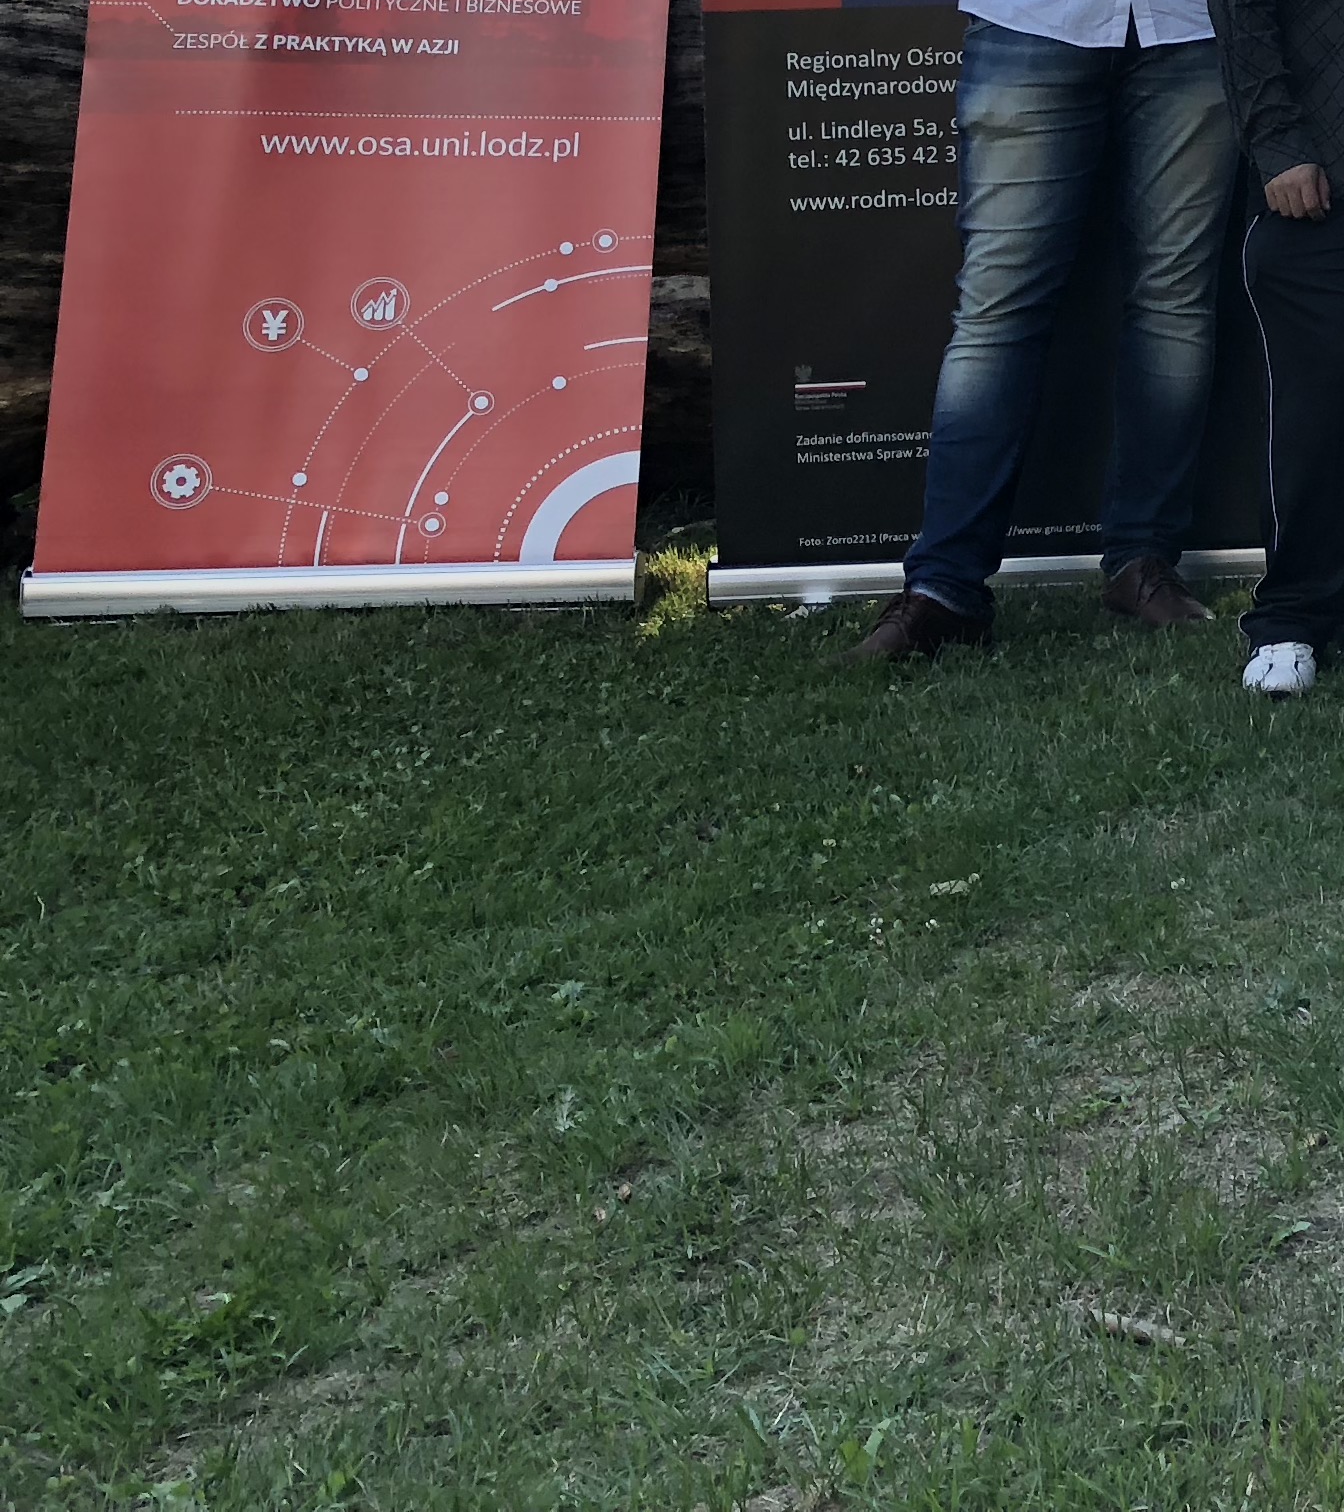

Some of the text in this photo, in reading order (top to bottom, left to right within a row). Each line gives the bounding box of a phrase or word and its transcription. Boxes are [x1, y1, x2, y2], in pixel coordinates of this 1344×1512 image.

[173, 30, 460, 56] ZESPÓŁ Z PRAKTYKĄ W AZJI
[786, 48, 901, 73] Regionalny
[786, 75, 958, 101] Międzynarodow
[788, 121, 813, 142] ul.
[821, 119, 906, 142] Lindleya
[913, 118, 945, 139] 5a,
[260, 130, 581, 163] www.osa.uni.lodz.pl
[787, 145, 957, 170] tel.: 42 635 42 3
[789, 187, 959, 212] www.rodm-lodz
[796, 433, 842, 446] Zadanie
[797, 450, 873, 464] Ministerstwa
[876, 447, 912, 462] Spraw
[799, 537, 825, 547] Foto:
[826, 533, 877, 546] Zorro2212
